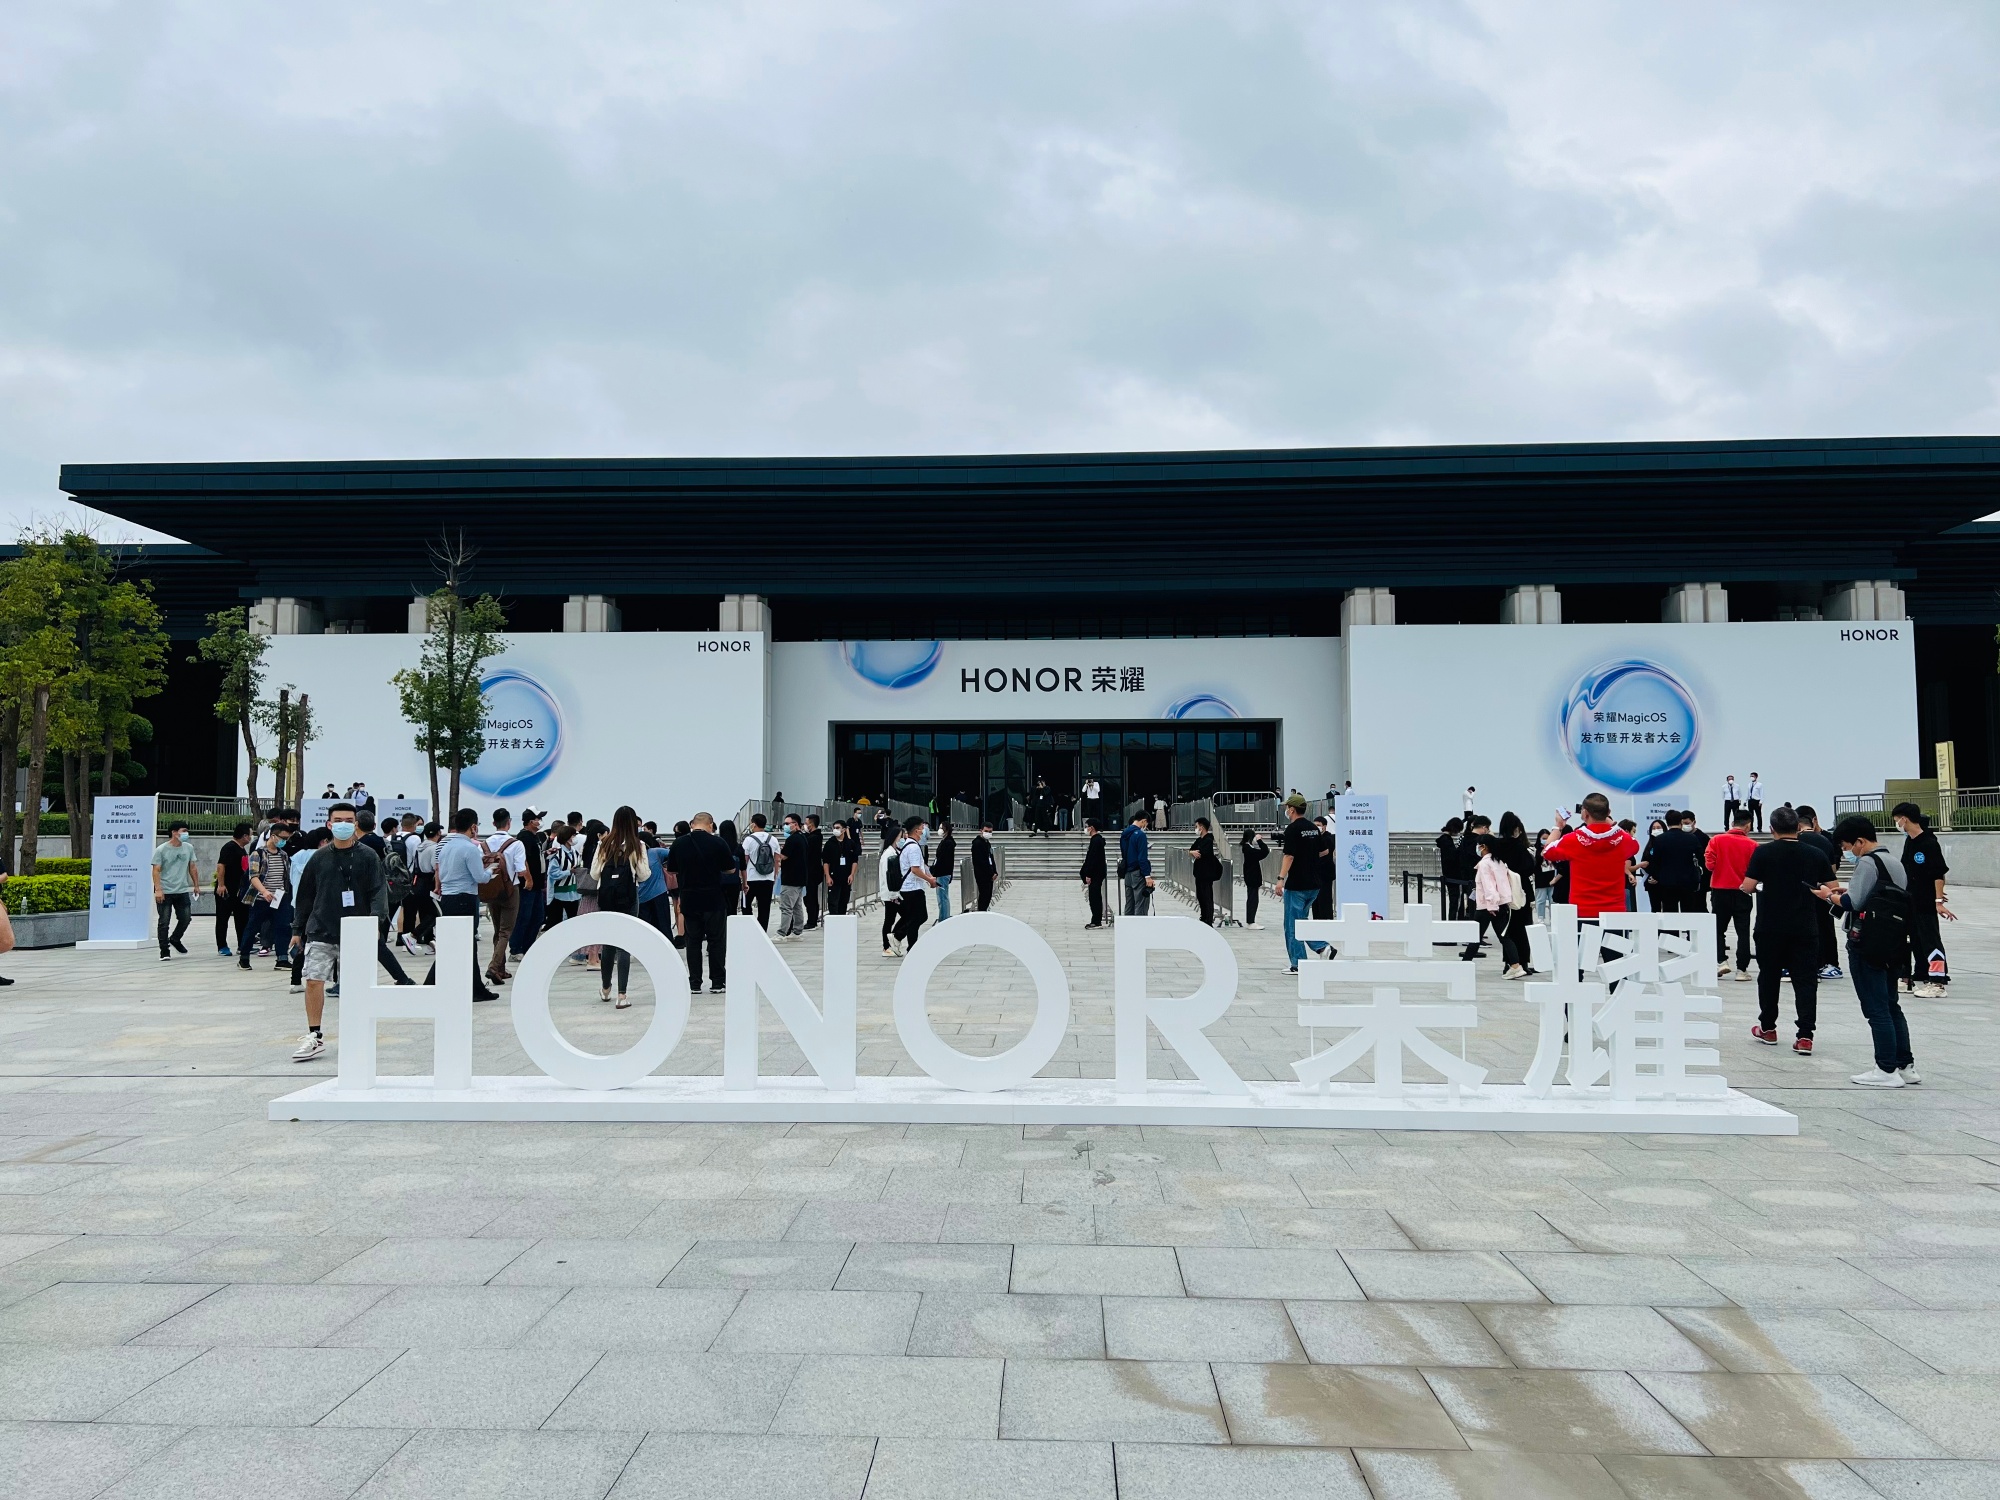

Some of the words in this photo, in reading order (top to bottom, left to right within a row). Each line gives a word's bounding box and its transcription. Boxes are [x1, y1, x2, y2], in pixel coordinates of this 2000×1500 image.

[1840, 629, 1899, 641] HONOR
[698, 640, 751, 652] HONOR
[961, 667, 1083, 693] HONOR
[1091, 666, 1145, 692] 荣耀
[1593, 711, 1667, 725] 荣耀MagicOS
[1039, 730, 1067, 746] A馆
[1581, 731, 1681, 744] 发布暨开发者大会
[337, 911, 1250, 1095] HONOR
[1289, 903, 1729, 1101] 荣耀
